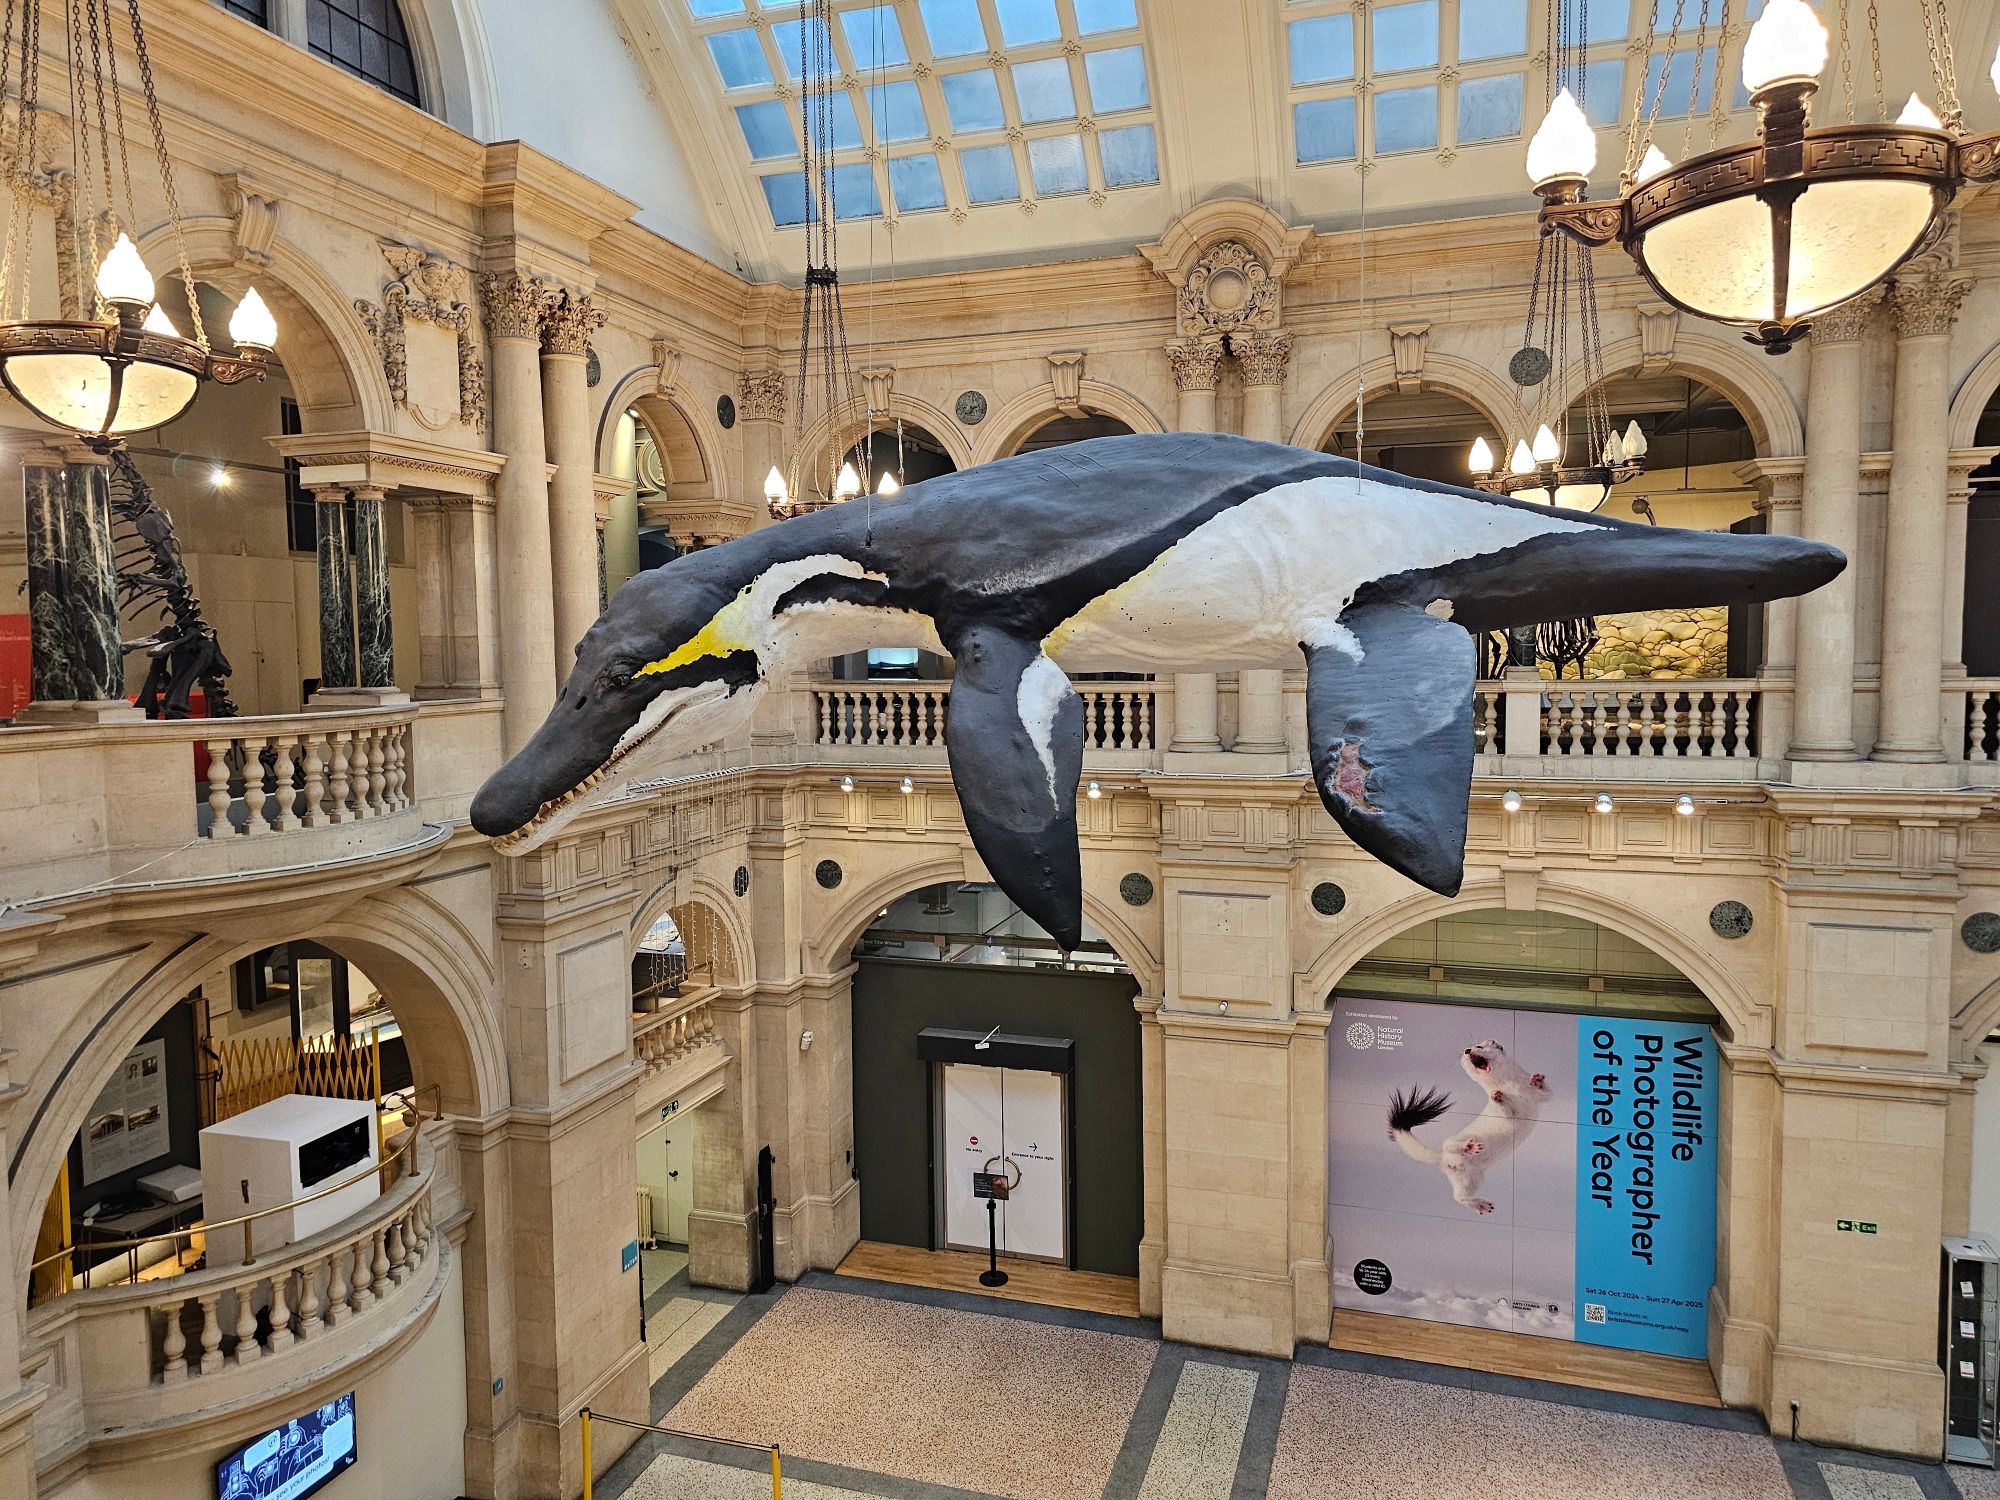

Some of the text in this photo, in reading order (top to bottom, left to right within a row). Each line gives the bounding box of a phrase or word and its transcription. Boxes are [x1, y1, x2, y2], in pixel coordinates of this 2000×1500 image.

[1377, 1025, 1403, 1033] Natural
[1377, 1032, 1402, 1041] History
[1377, 1038, 1403, 1046] Museum
[1672, 1036, 1703, 1162] Wildlife
[1591, 1030, 1622, 1208] of the Year
[1626, 1034, 1663, 1265] Photographer
[1671, 1298, 1684, 1307] Apr
[1685, 1300, 1703, 1308] 2025
[290, 1475, 304, 1491] your
[305, 1455, 330, 1479] photos!
